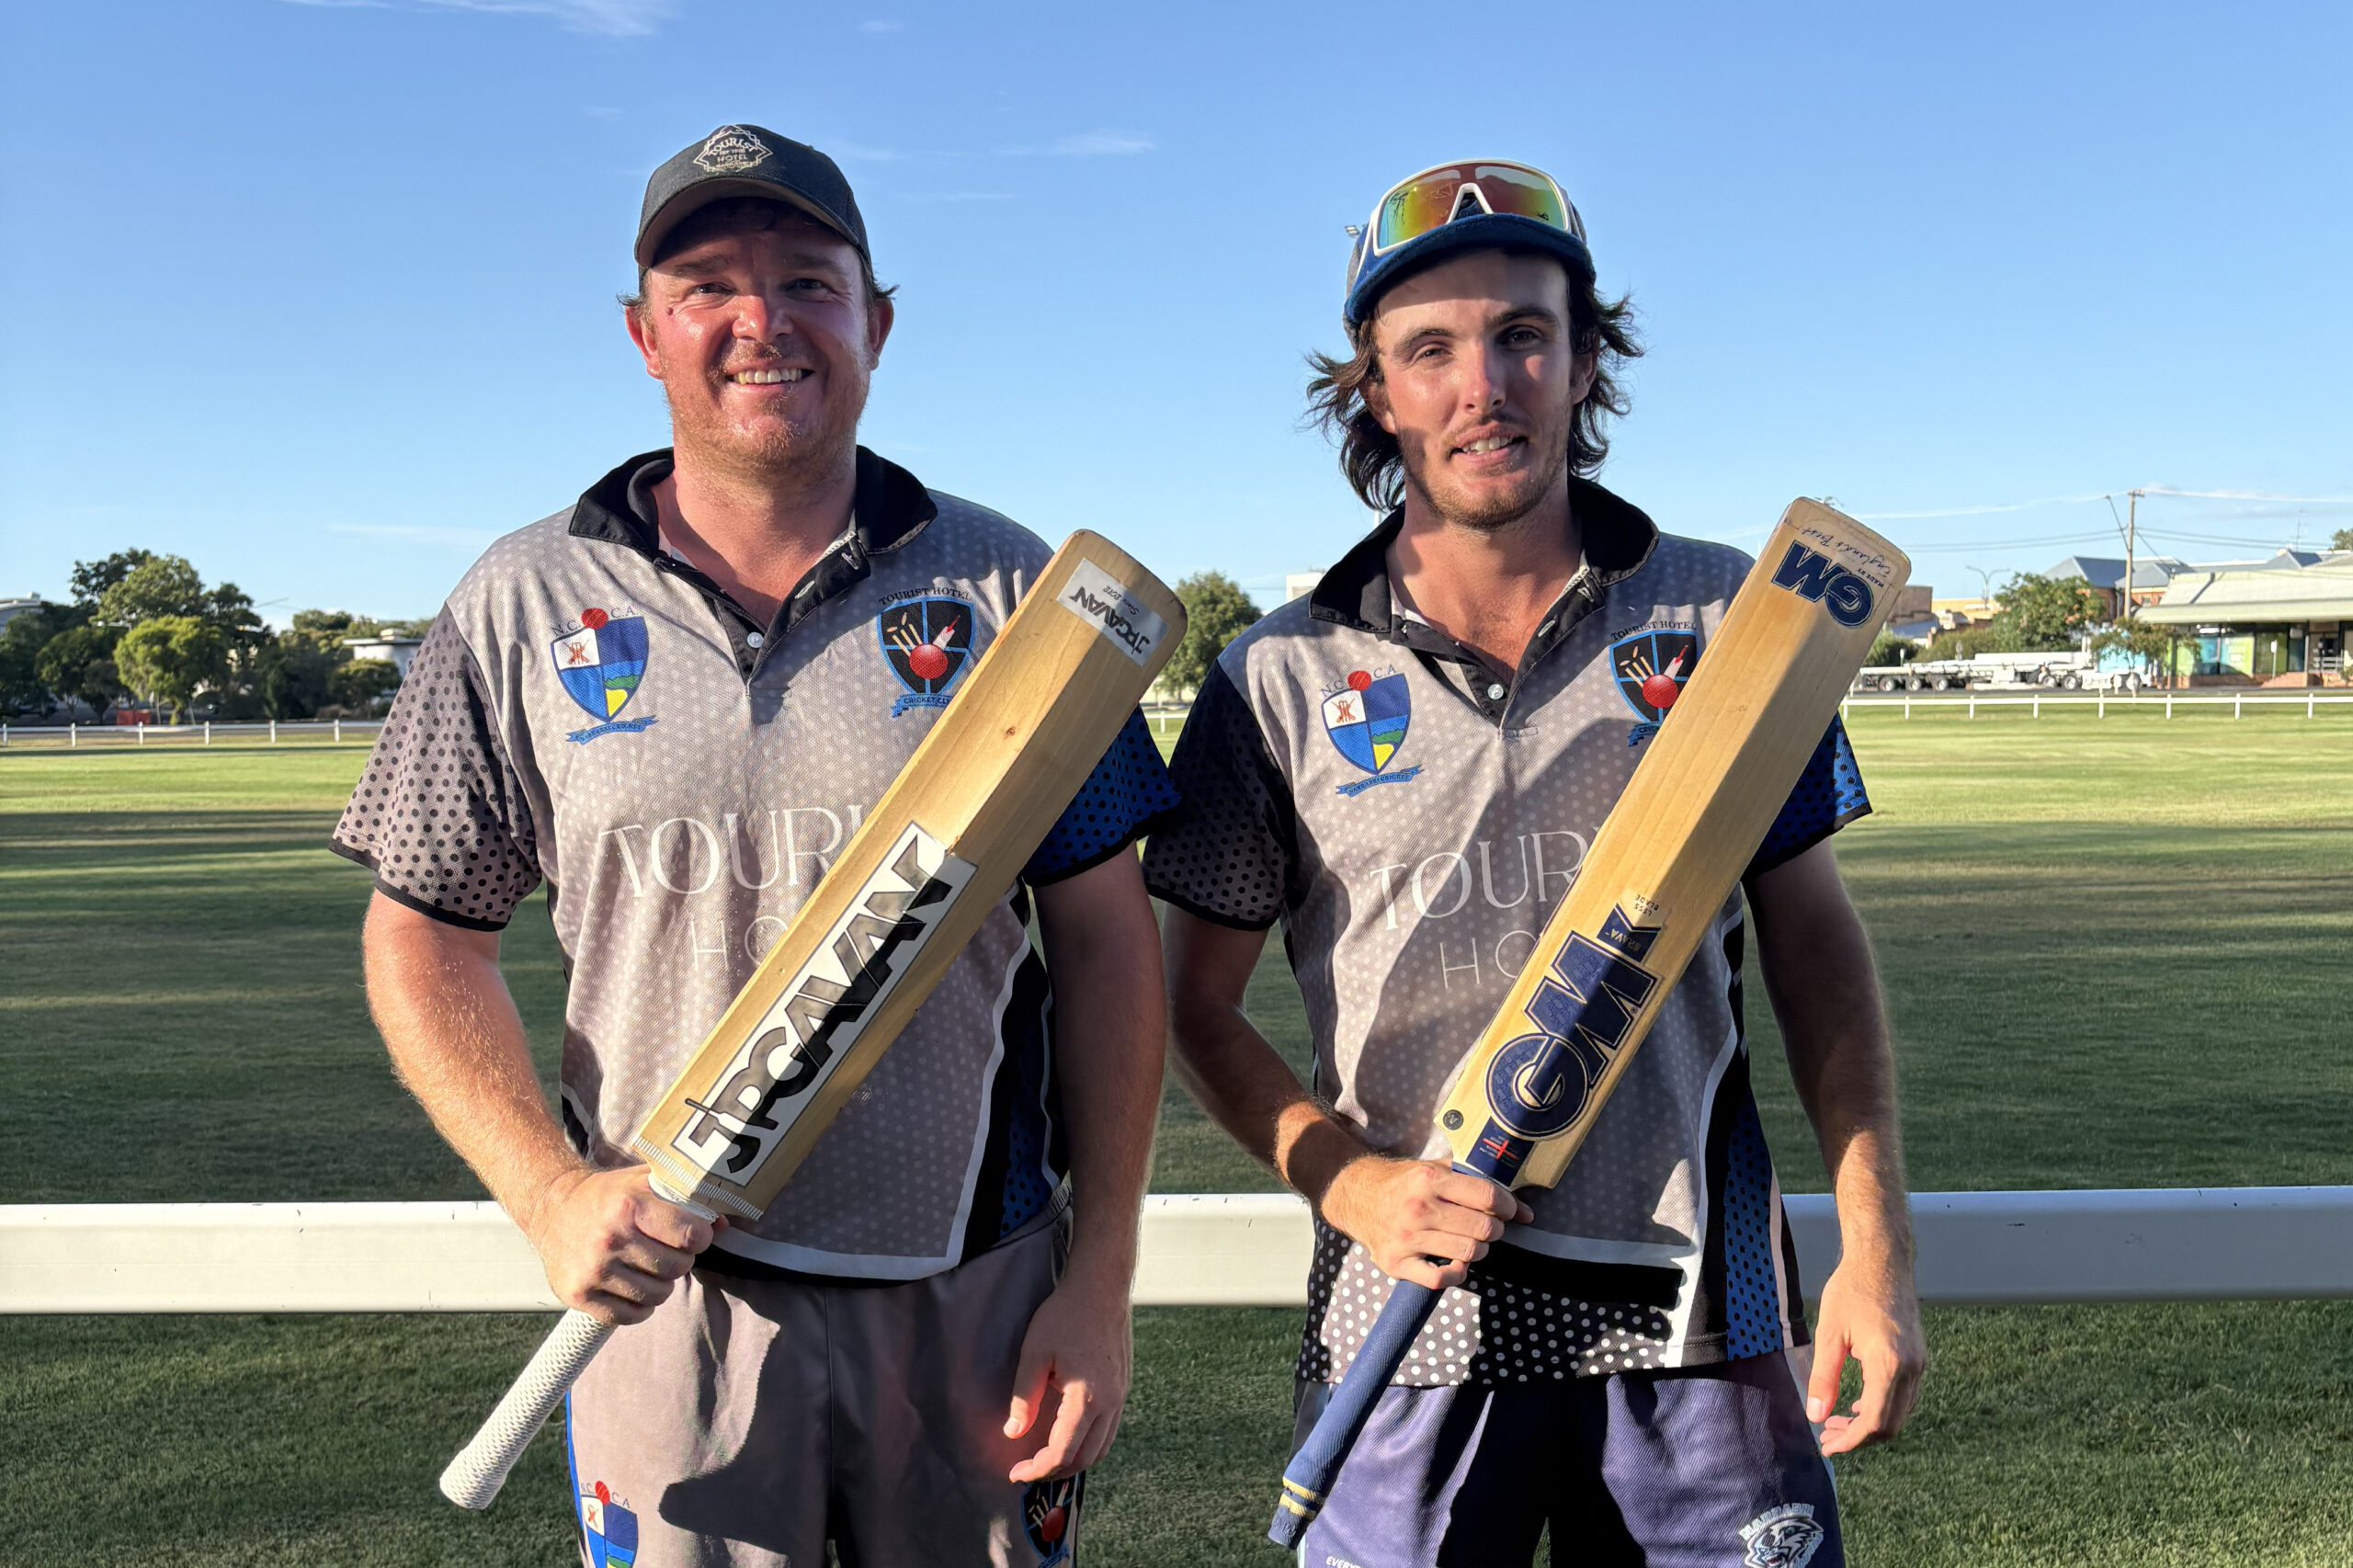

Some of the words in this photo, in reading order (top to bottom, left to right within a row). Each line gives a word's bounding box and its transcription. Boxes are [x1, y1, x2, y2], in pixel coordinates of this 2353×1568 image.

[707, 137, 758, 156] TOURIST
[717, 153, 748, 163] HOTEL
[879, 587, 930, 606] TOURIST
[932, 586, 972, 601] HOTEL
[1770, 540, 1874, 627] GM
[1068, 586, 1151, 654] JPGAVAN
[1610, 621, 1657, 641] TOURIST
[1659, 620, 1698, 631] HOTEL
[904, 696, 936, 705] CRICKET
[1370, 826, 1600, 931] TOUR
[685, 835, 953, 1174] JPGAVAN
[1485, 930, 1660, 1138] GM
